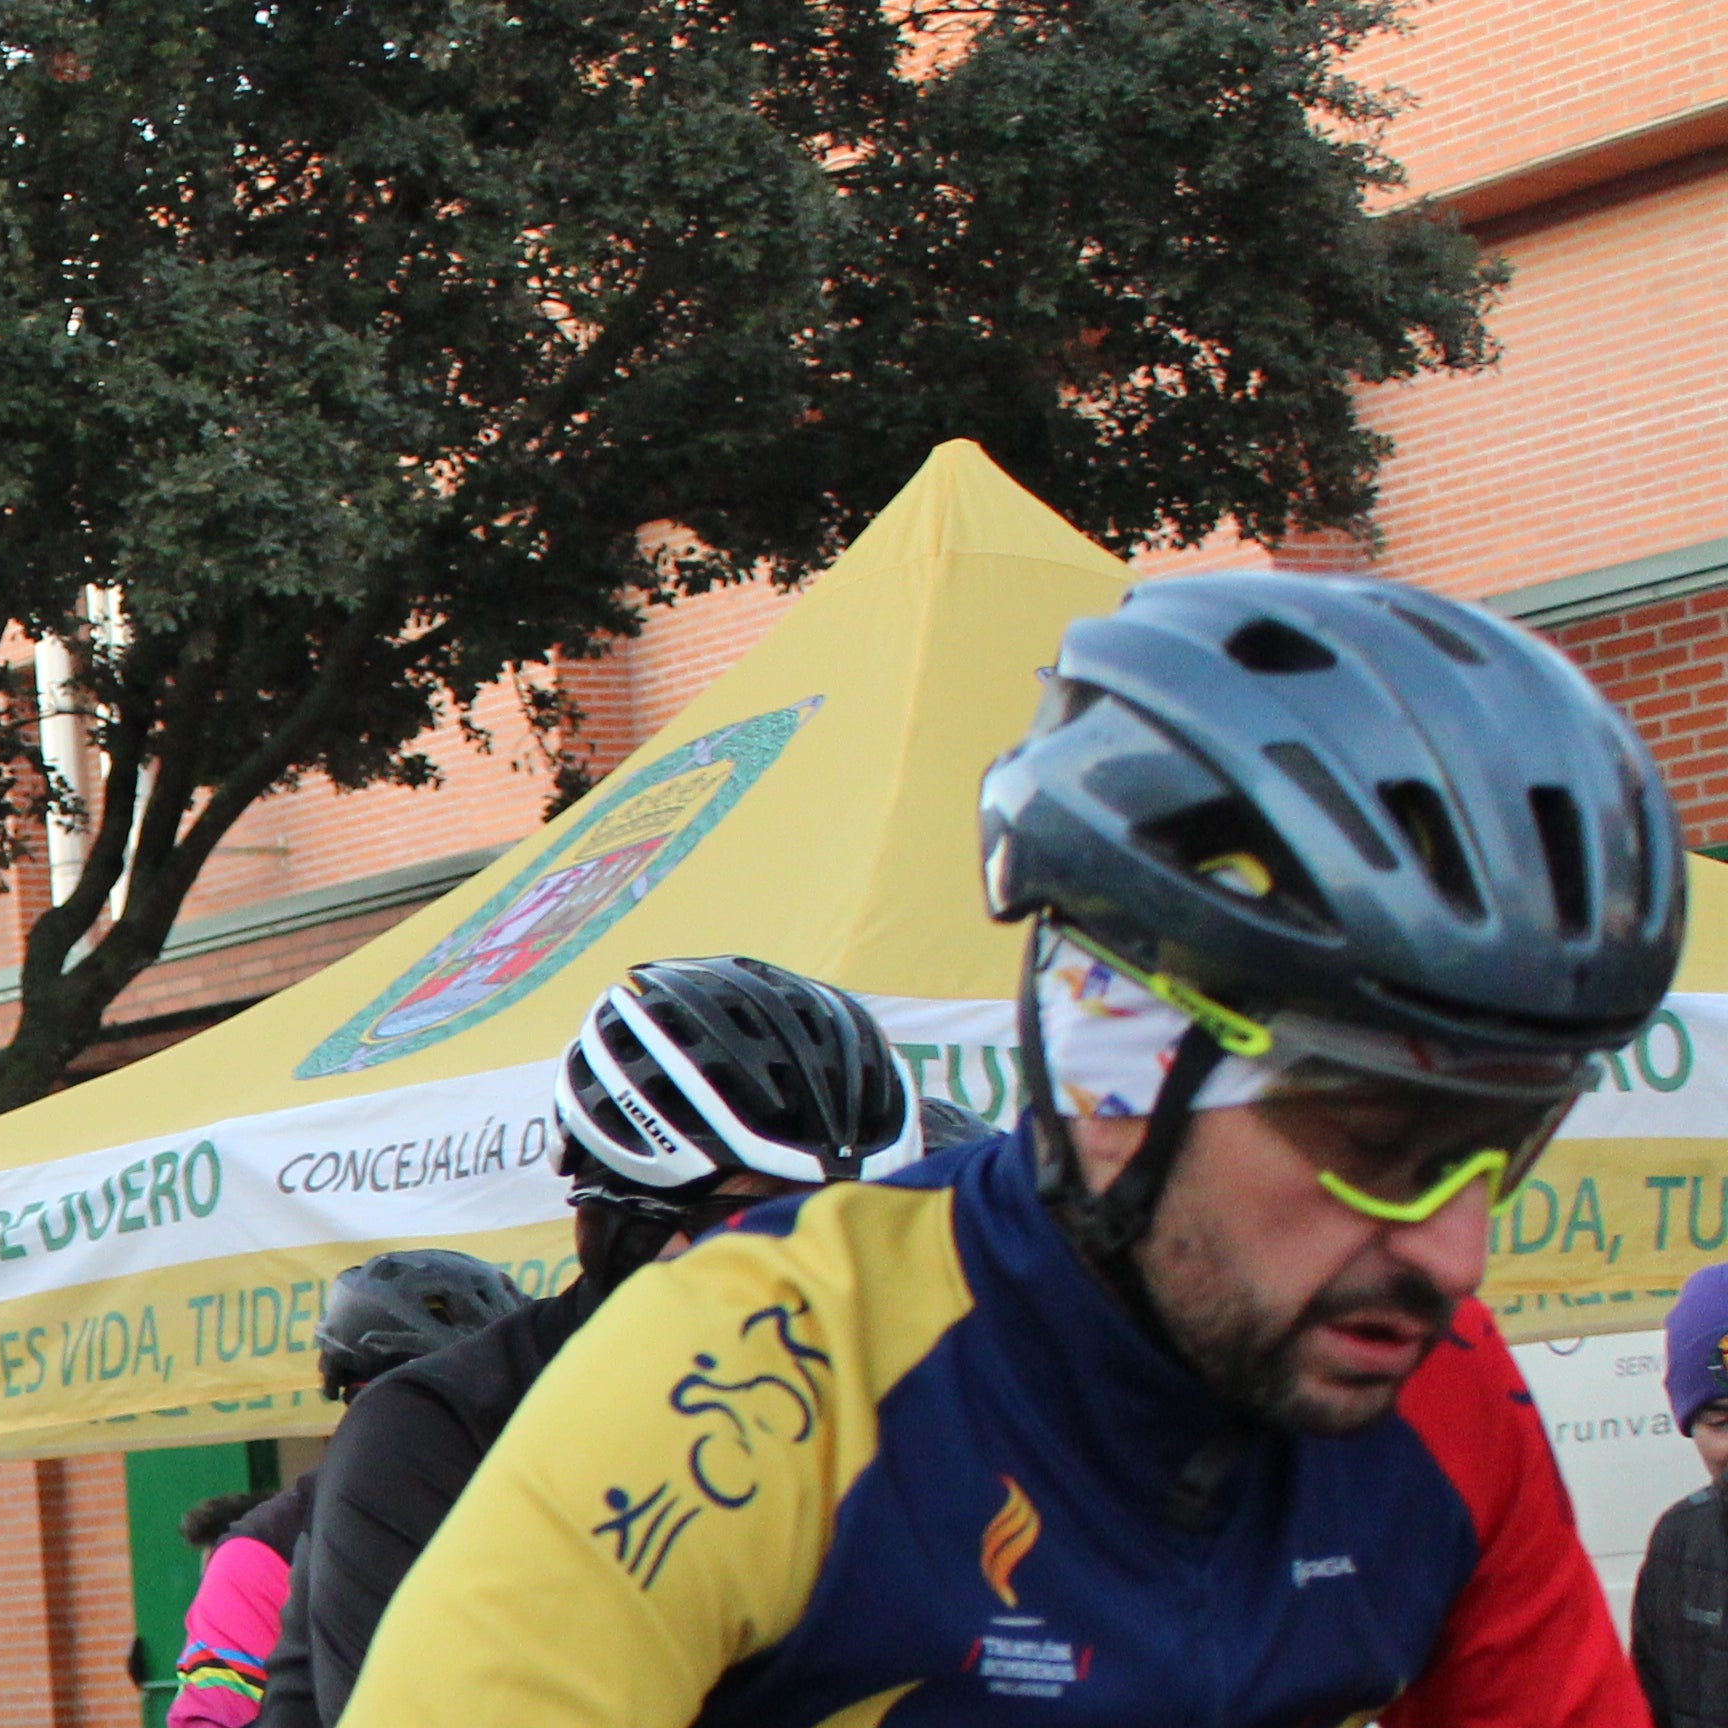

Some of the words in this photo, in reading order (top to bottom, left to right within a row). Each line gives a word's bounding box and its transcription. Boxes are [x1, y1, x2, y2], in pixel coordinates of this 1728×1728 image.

[276, 1116, 507, 1194] CONCEJALÍA
[616, 1088, 680, 1155] hebo
[61, 1304, 174, 1386] VIDA,
